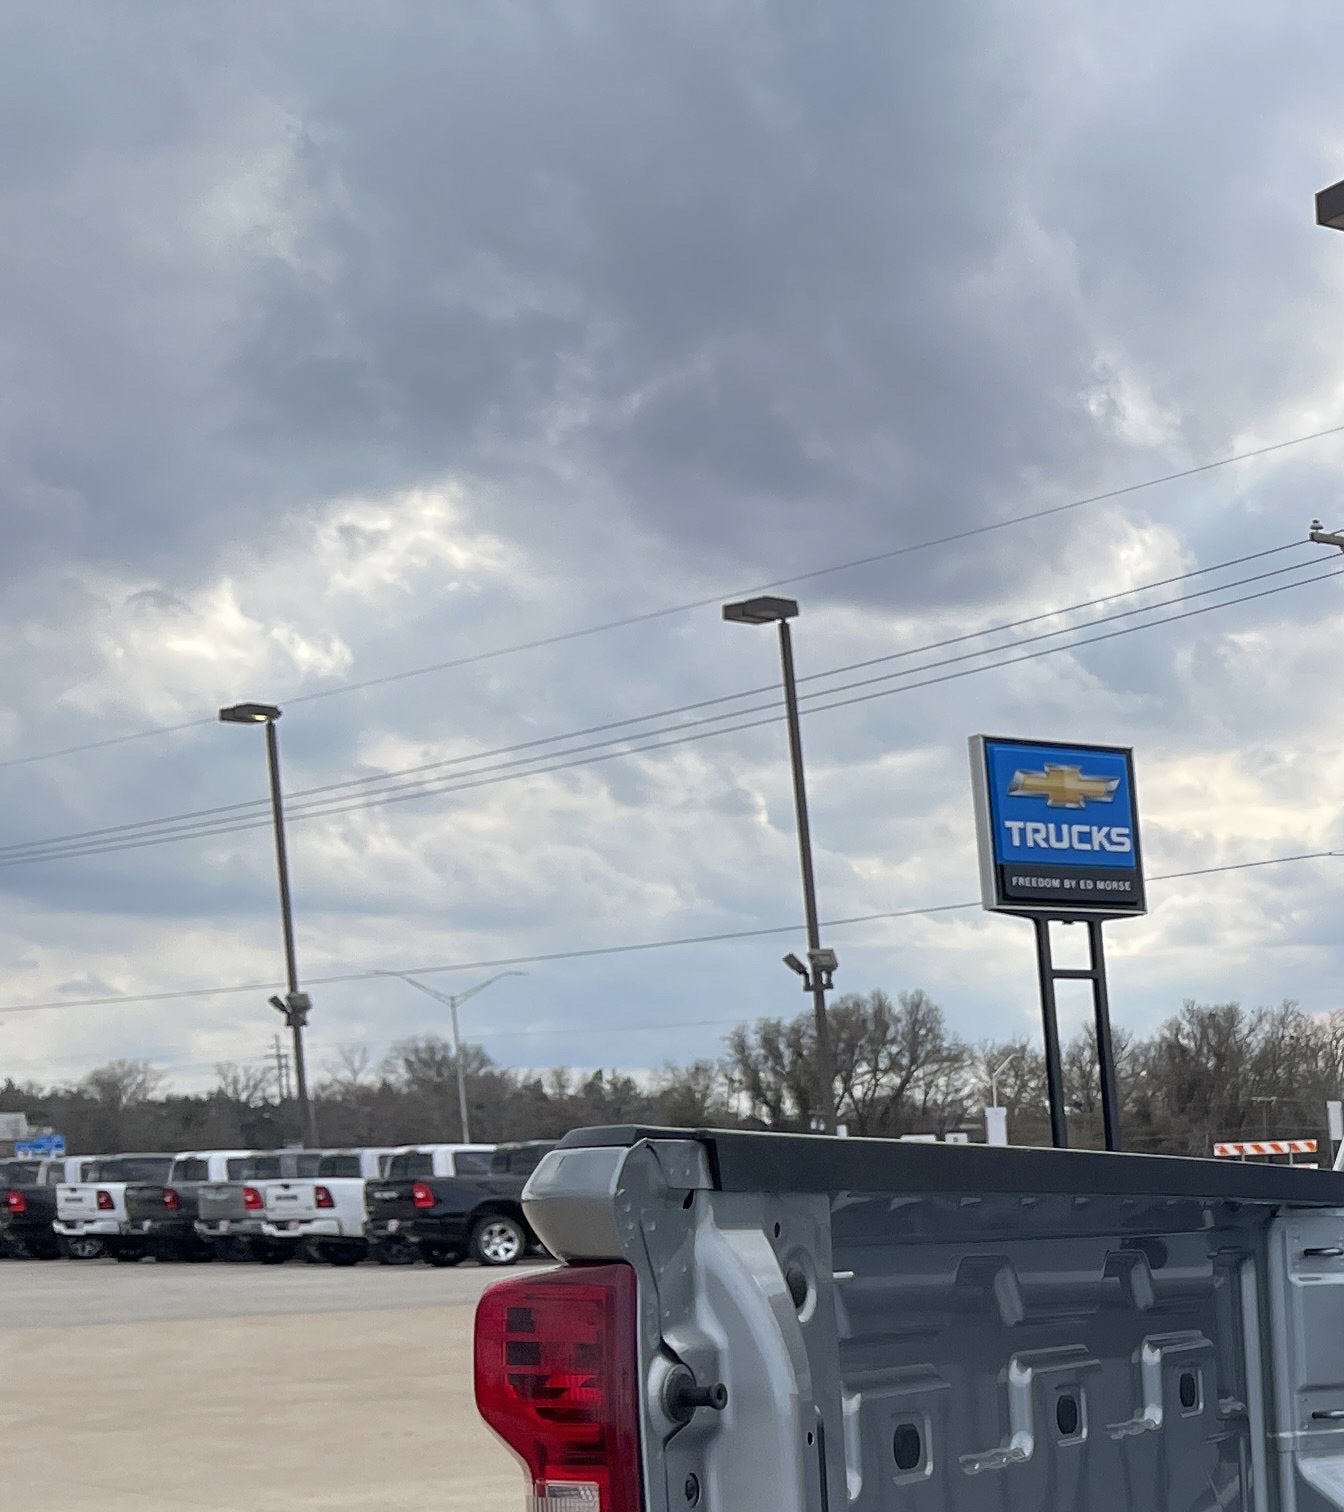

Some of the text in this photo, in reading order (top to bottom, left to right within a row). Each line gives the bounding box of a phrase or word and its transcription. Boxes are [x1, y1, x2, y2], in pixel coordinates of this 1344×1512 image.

[1003, 820, 1132, 853] TRUCKS
[1011, 876, 1132, 891] FREEDOM BY ED MORSE
